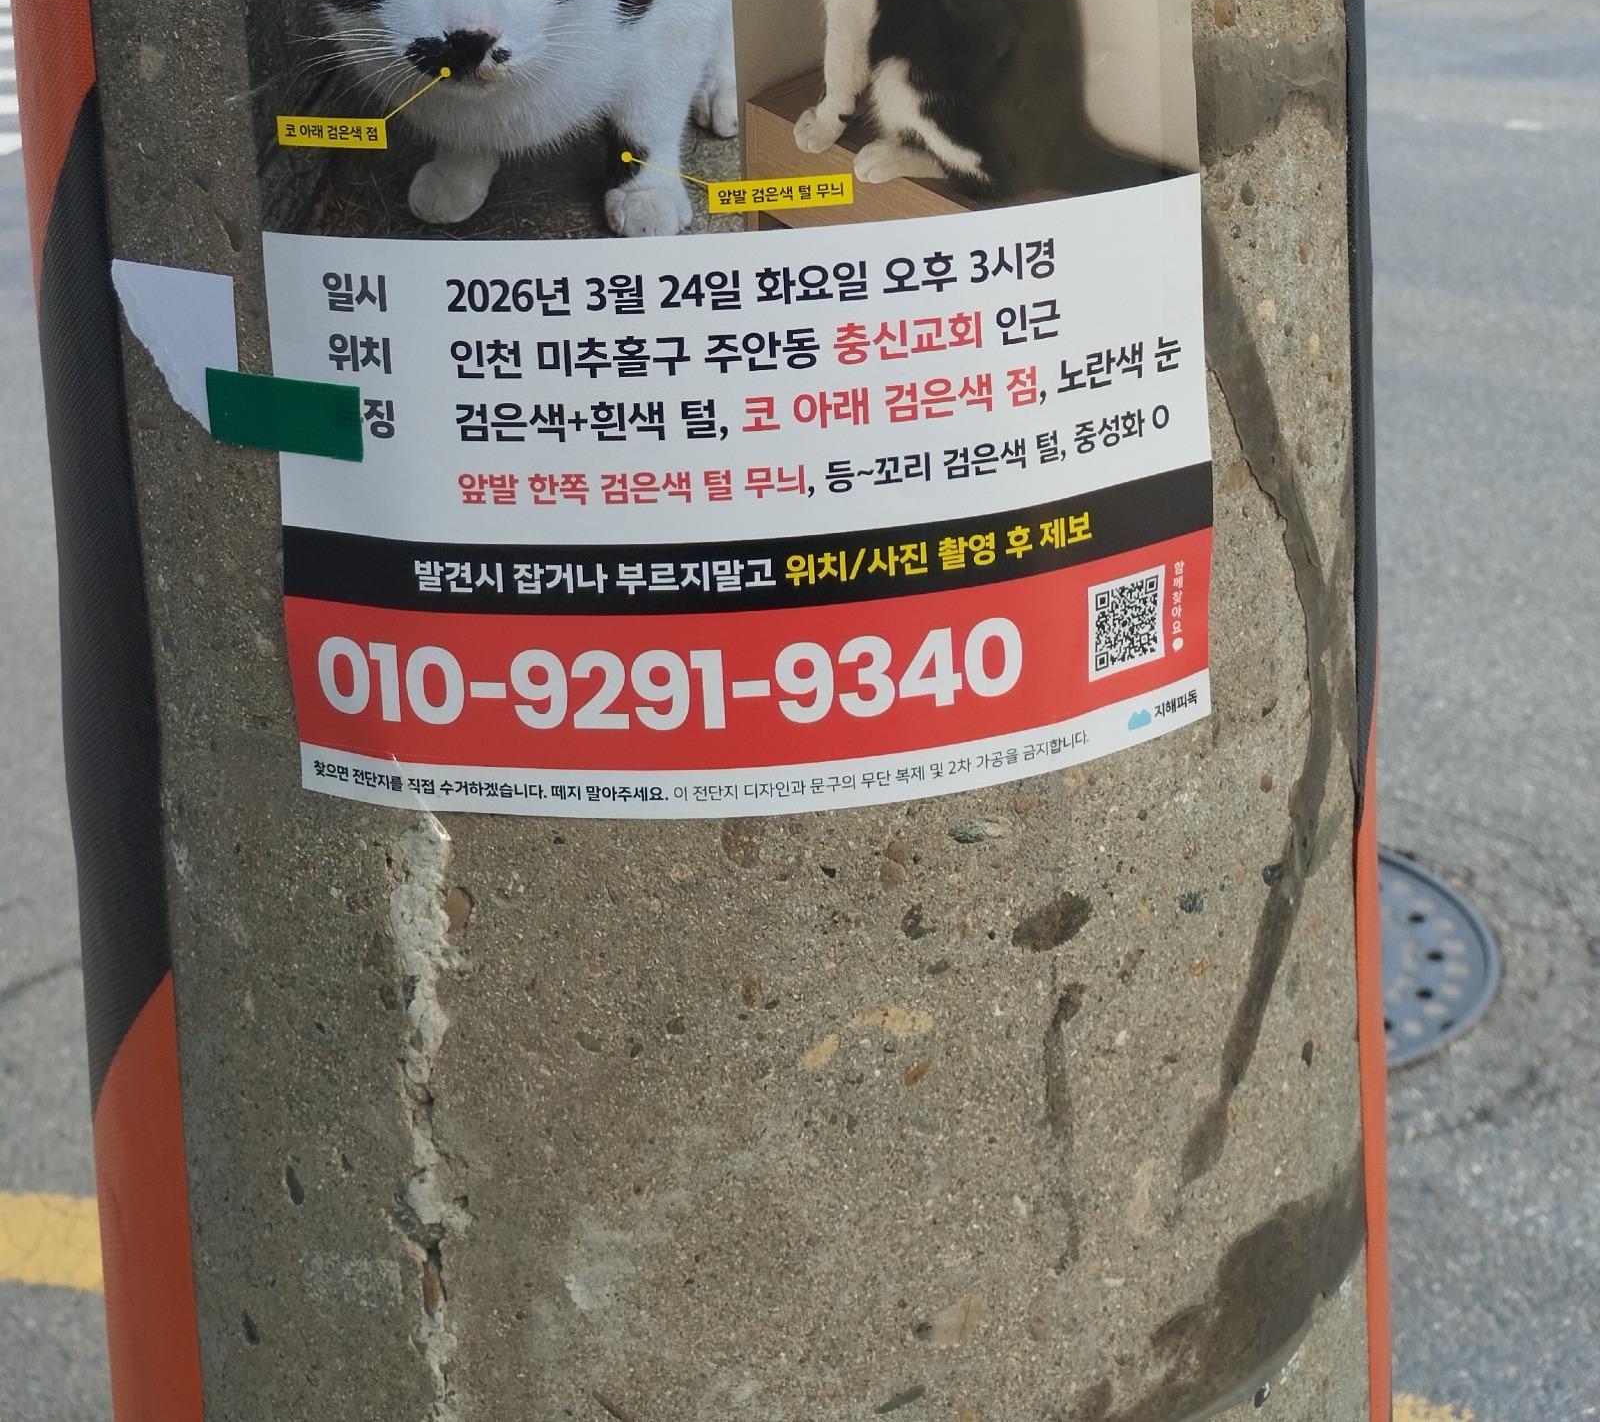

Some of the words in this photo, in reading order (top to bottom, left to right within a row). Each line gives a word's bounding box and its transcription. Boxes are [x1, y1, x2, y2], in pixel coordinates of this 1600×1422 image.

[285, 124, 297, 137] 코
[300, 124, 323, 138] 아래
[327, 125, 362, 141] 검은색
[366, 126, 378, 141] 점
[718, 189, 747, 205] 앞발
[752, 186, 793, 203] 검은색
[798, 184, 811, 200] 털
[816, 182, 844, 198] 무늬
[322, 272, 388, 313] 일시
[446, 276, 571, 317] 2026년
[585, 274, 645, 315] 3월
[659, 270, 741, 311] 24일
[756, 260, 868, 305] 화요일
[883, 251, 957, 294] 오후
[970, 238, 1055, 283] 3시경
[329, 333, 392, 374] 위치
[450, 339, 522, 379] 인천
[537, 335, 691, 378] 미추홀구
[704, 327, 820, 374] 주안동
[833, 311, 983, 366] 충신교회
[995, 298, 1061, 346] 인근
[455, 401, 665, 443] 검은색+흰색
[680, 398, 728, 440] 털,
[742, 397, 781, 433] 코
[792, 386, 870, 431] 아래
[885, 373, 993, 423] 검은색
[1005, 365, 1047, 407] 점,
[1056, 341, 1144, 395] 노란색
[1155, 335, 1181, 372] 눈
[458, 472, 518, 507] 앞발
[528, 472, 590, 506] 한쪽
[600, 471, 692, 505] 검은색
[703, 468, 733, 502] 털
[744, 464, 814, 499] 무늬,
[825, 452, 931, 493] 등~꼬리
[943, 438, 1027, 479] 검은색
[1036, 430, 1067, 462] 털,
[1073, 408, 1145, 455] 중성화
[414, 559, 503, 593] 발견시
[512, 562, 608, 595] 잡거나
[615, 558, 777, 593] 부르지말고
[784, 541, 929, 587] 위치/사진
[937, 532, 998, 571] 촬영
[1005, 525, 1033, 559] 후
[1040, 511, 1093, 550] 제보
[317, 617, 1022, 731] 010-9291-9340
[1154, 688, 1198, 719] 지해피독
[313, 760, 349, 782] 찾으면
[352, 768, 403, 793] 전단지를
[407, 778, 435, 795] 직접
[439, 779, 547, 800] 수거하겠습니다.
[551, 785, 581, 801] 떼지
[585, 785, 669, 802] 말아주세요.
[673, 785, 688, 801] 이
[692, 784, 738, 802] 전단지
[744, 780, 806, 799] 디자인과
[810, 774, 856, 795] 문구의
[861, 769, 890, 789] 무단
[895, 764, 925, 783] 복제
[930, 762, 944, 779] 및
[948, 757, 972, 775] 2차
[976, 748, 1019, 770] 가공을
[1022, 729, 1089, 762] 금지합니다.
